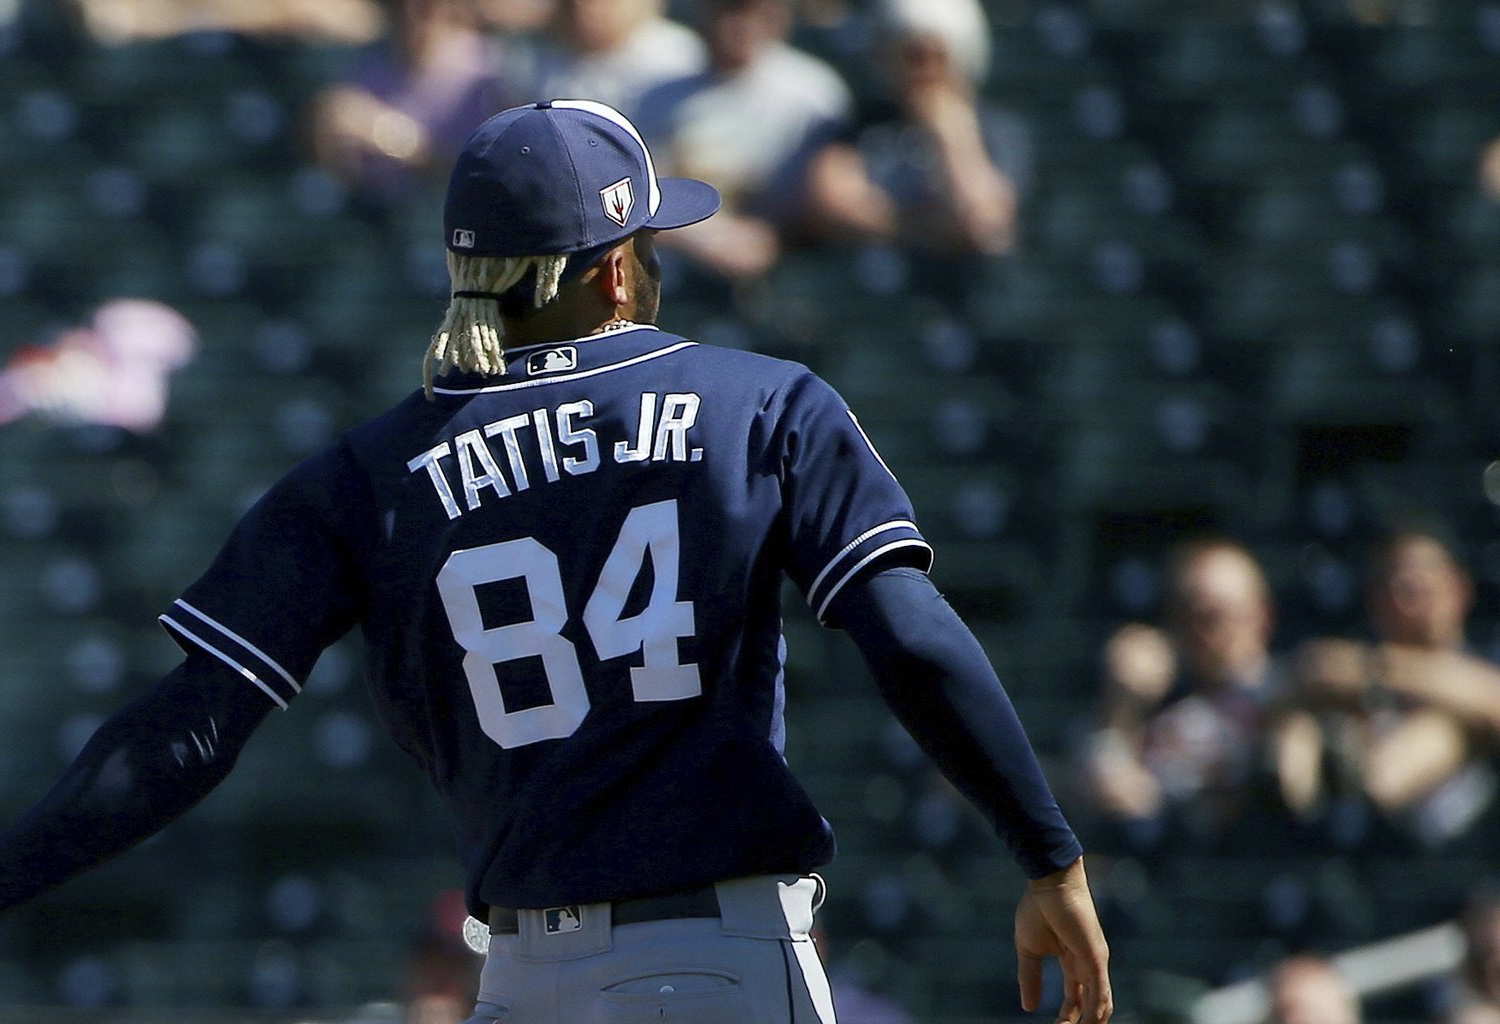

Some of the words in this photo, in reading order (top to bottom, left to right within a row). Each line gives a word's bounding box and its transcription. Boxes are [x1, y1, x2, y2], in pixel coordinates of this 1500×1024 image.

[407, 399, 600, 520] TATIS
[614, 392, 704, 464] JR.
[436, 499, 702, 750] 84
